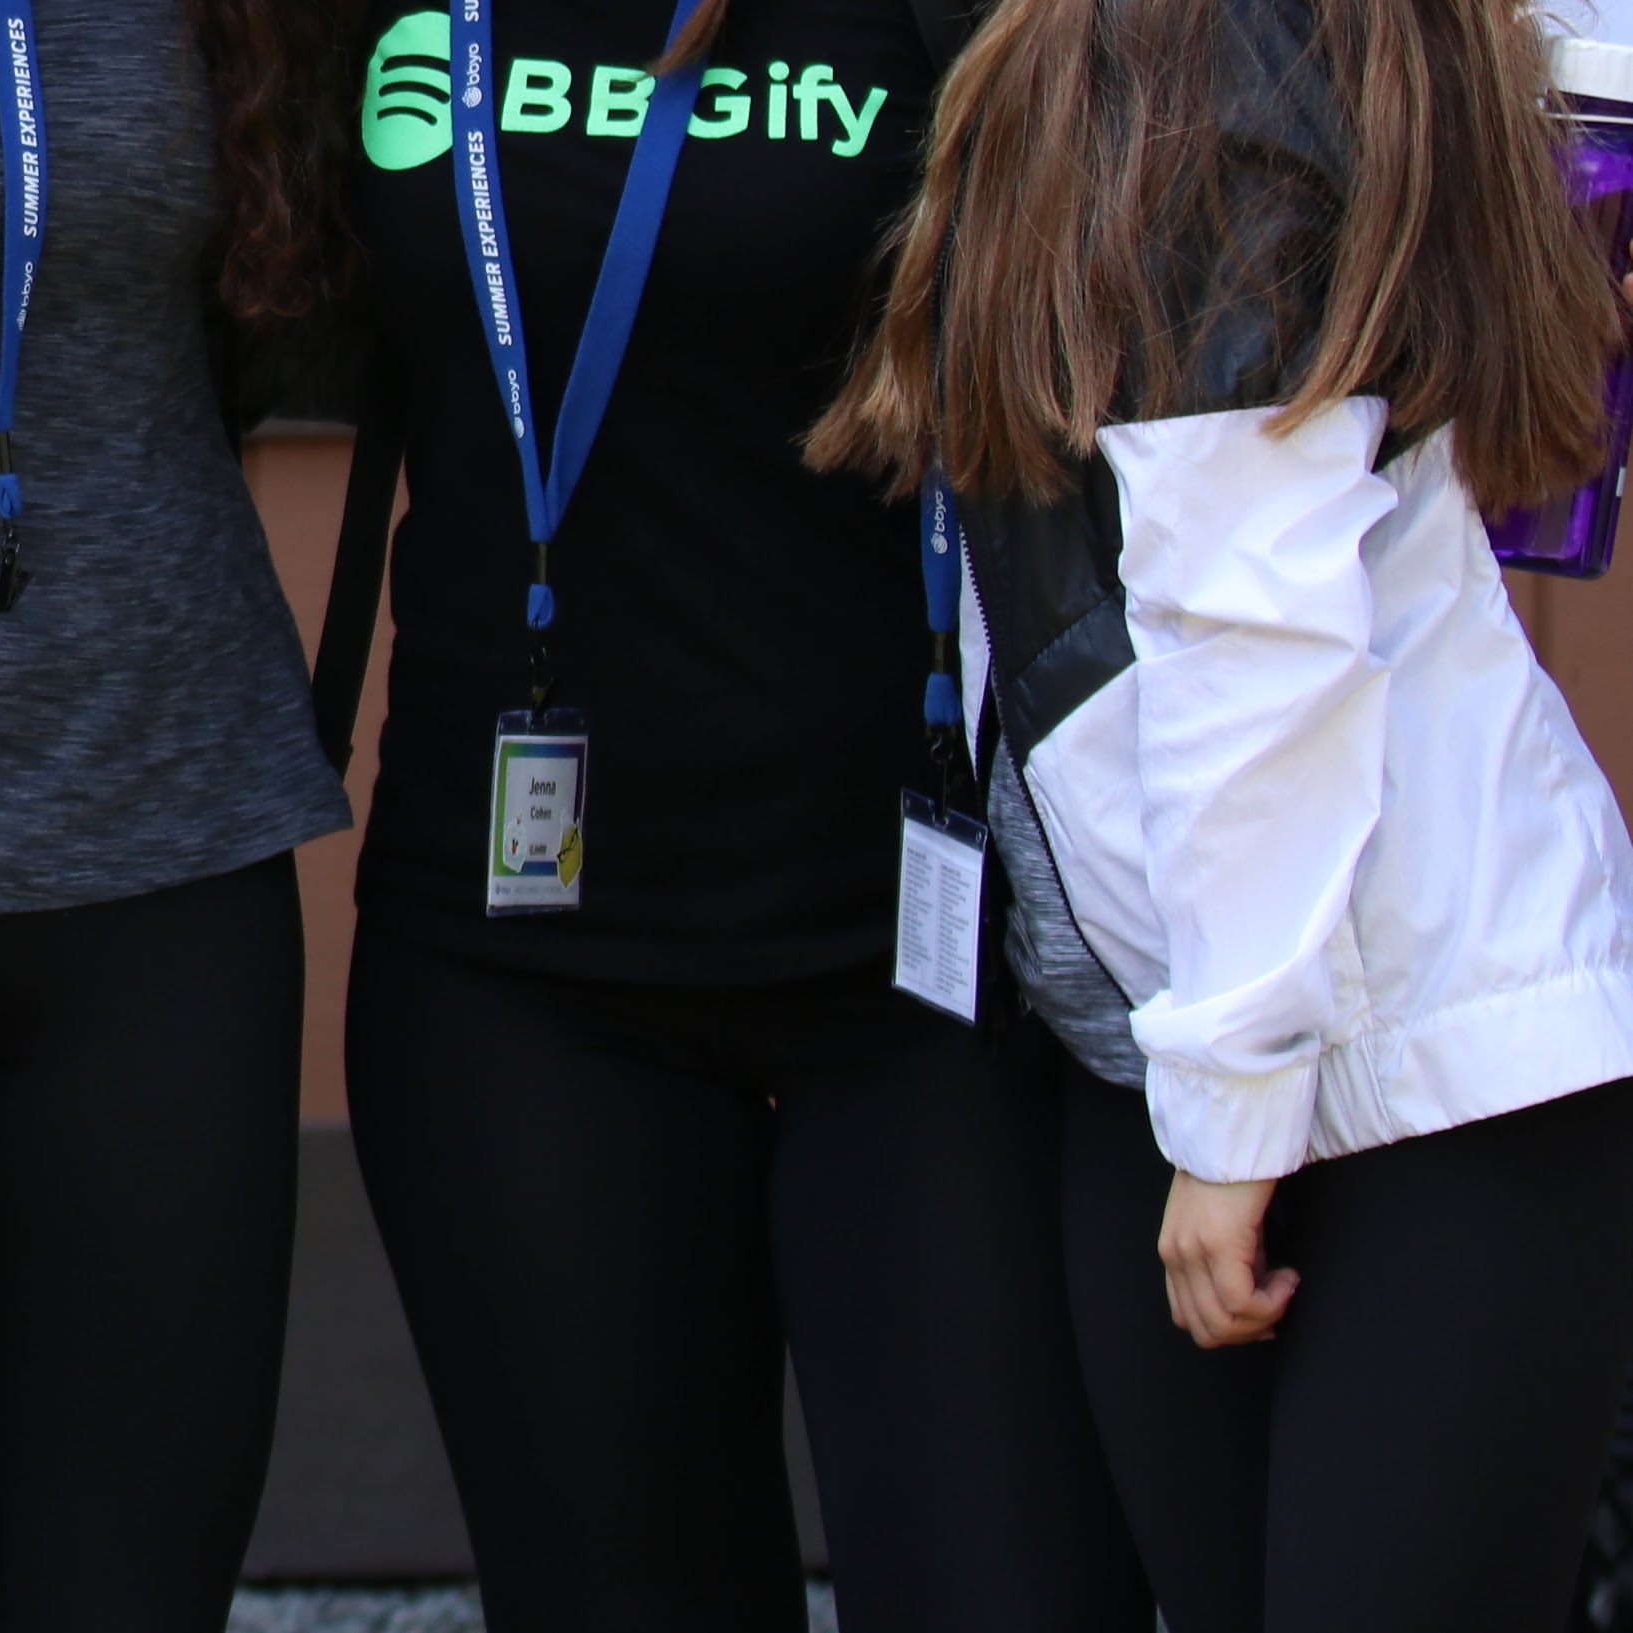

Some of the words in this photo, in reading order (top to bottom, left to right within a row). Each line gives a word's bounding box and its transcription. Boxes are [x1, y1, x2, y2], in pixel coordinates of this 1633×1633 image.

[7, 18, 38, 148] EXPERIENCES
[468, 43, 482, 87] bbyo
[501, 58, 889, 158] BBGify
[22, 151, 39, 238] SUMMER
[467, 130, 499, 258] EXPERIENCES
[22, 262, 34, 307] bbyo
[486, 261, 512, 346] SUMMER
[934, 491, 946, 533] bbyo
[529, 776, 556, 796] Jenna
